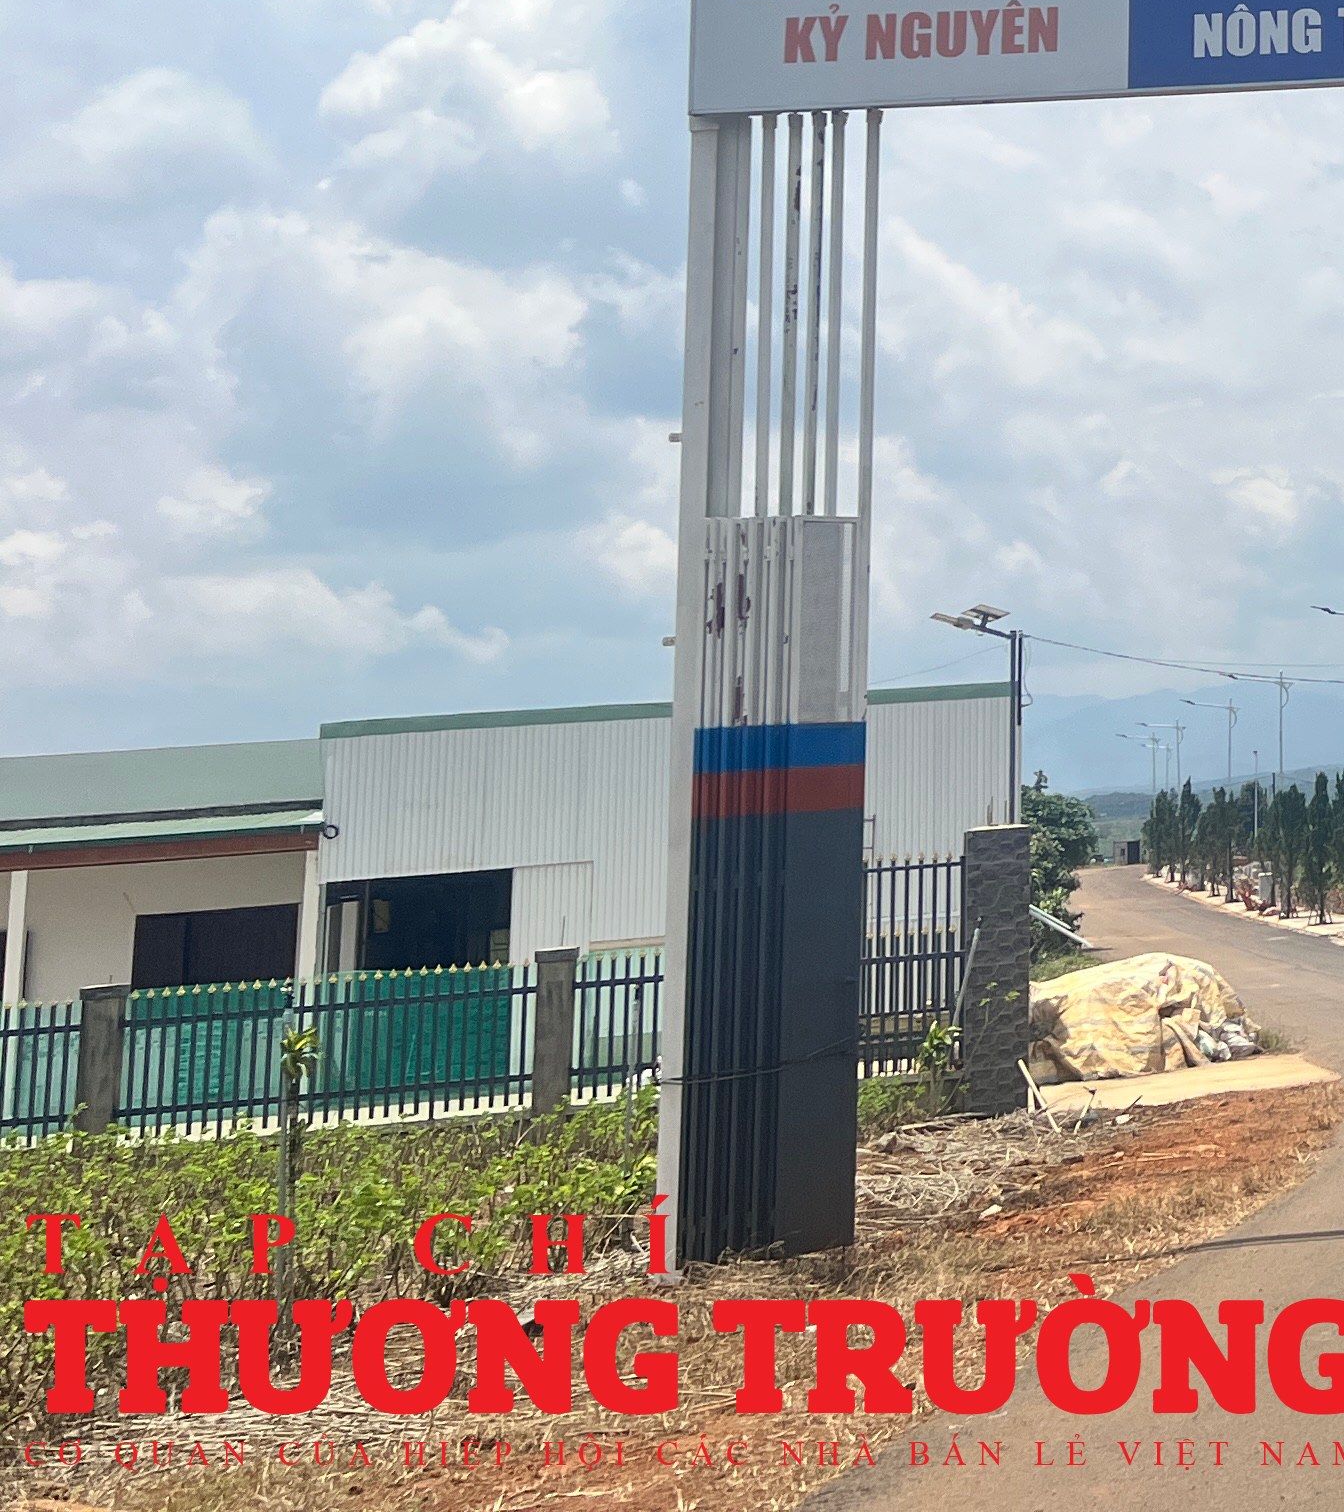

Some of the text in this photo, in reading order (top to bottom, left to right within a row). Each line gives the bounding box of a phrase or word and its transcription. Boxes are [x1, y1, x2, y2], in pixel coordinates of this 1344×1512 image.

[783, 0, 1059, 64] KỶ NGUYÊN
[1193, 3, 1323, 59] NÔNG
